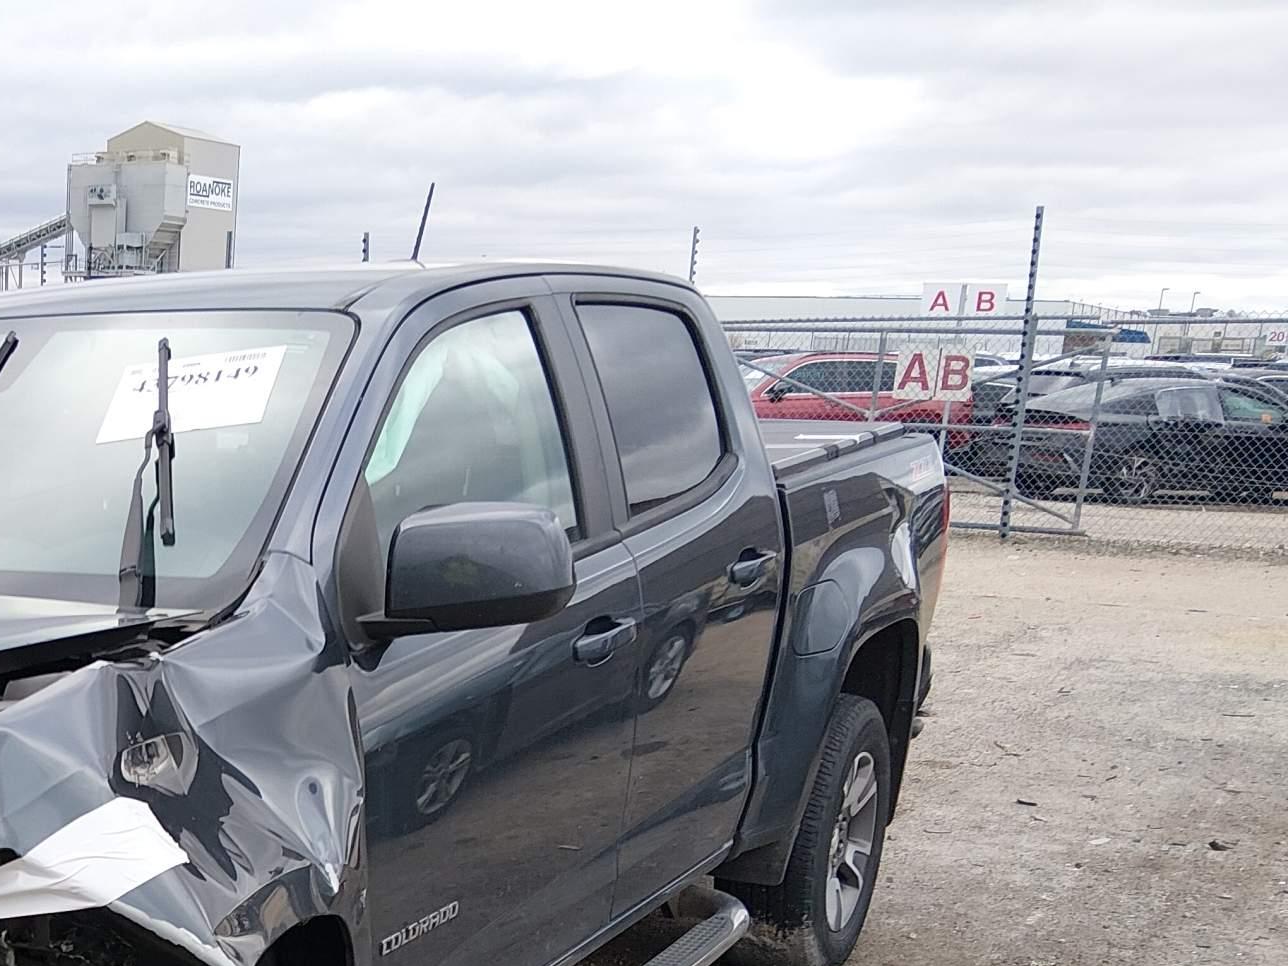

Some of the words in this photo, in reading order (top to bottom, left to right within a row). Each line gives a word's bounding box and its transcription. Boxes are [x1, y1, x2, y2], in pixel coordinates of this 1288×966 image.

[189, 180, 232, 198] ROANOKE
[929, 290, 950, 312] A
[976, 291, 995, 312] B
[381, 901, 459, 956] COLORADO
